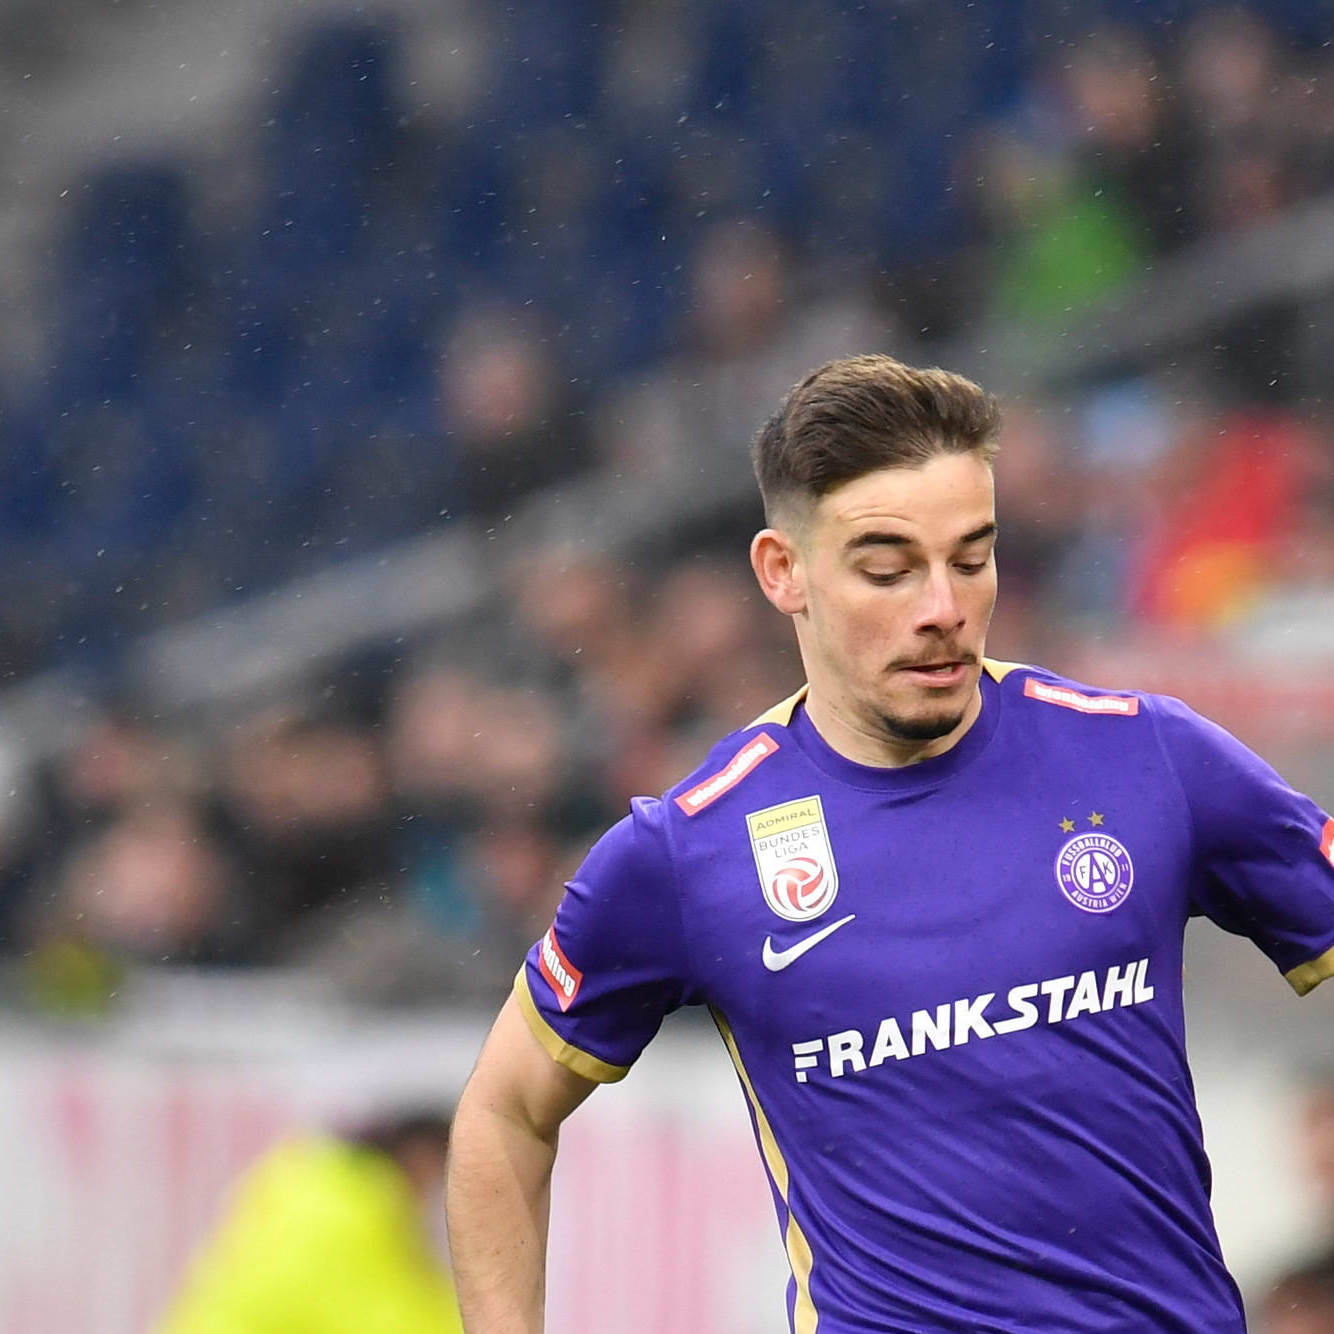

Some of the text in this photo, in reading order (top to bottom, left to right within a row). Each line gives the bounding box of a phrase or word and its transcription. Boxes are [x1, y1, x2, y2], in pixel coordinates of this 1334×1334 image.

[756, 808, 817, 832] ADMIRAL
[759, 826, 820, 851] BUNDES
[774, 842, 809, 858] LIGA
[1071, 882, 1127, 908] AUSTRIA WIEN
